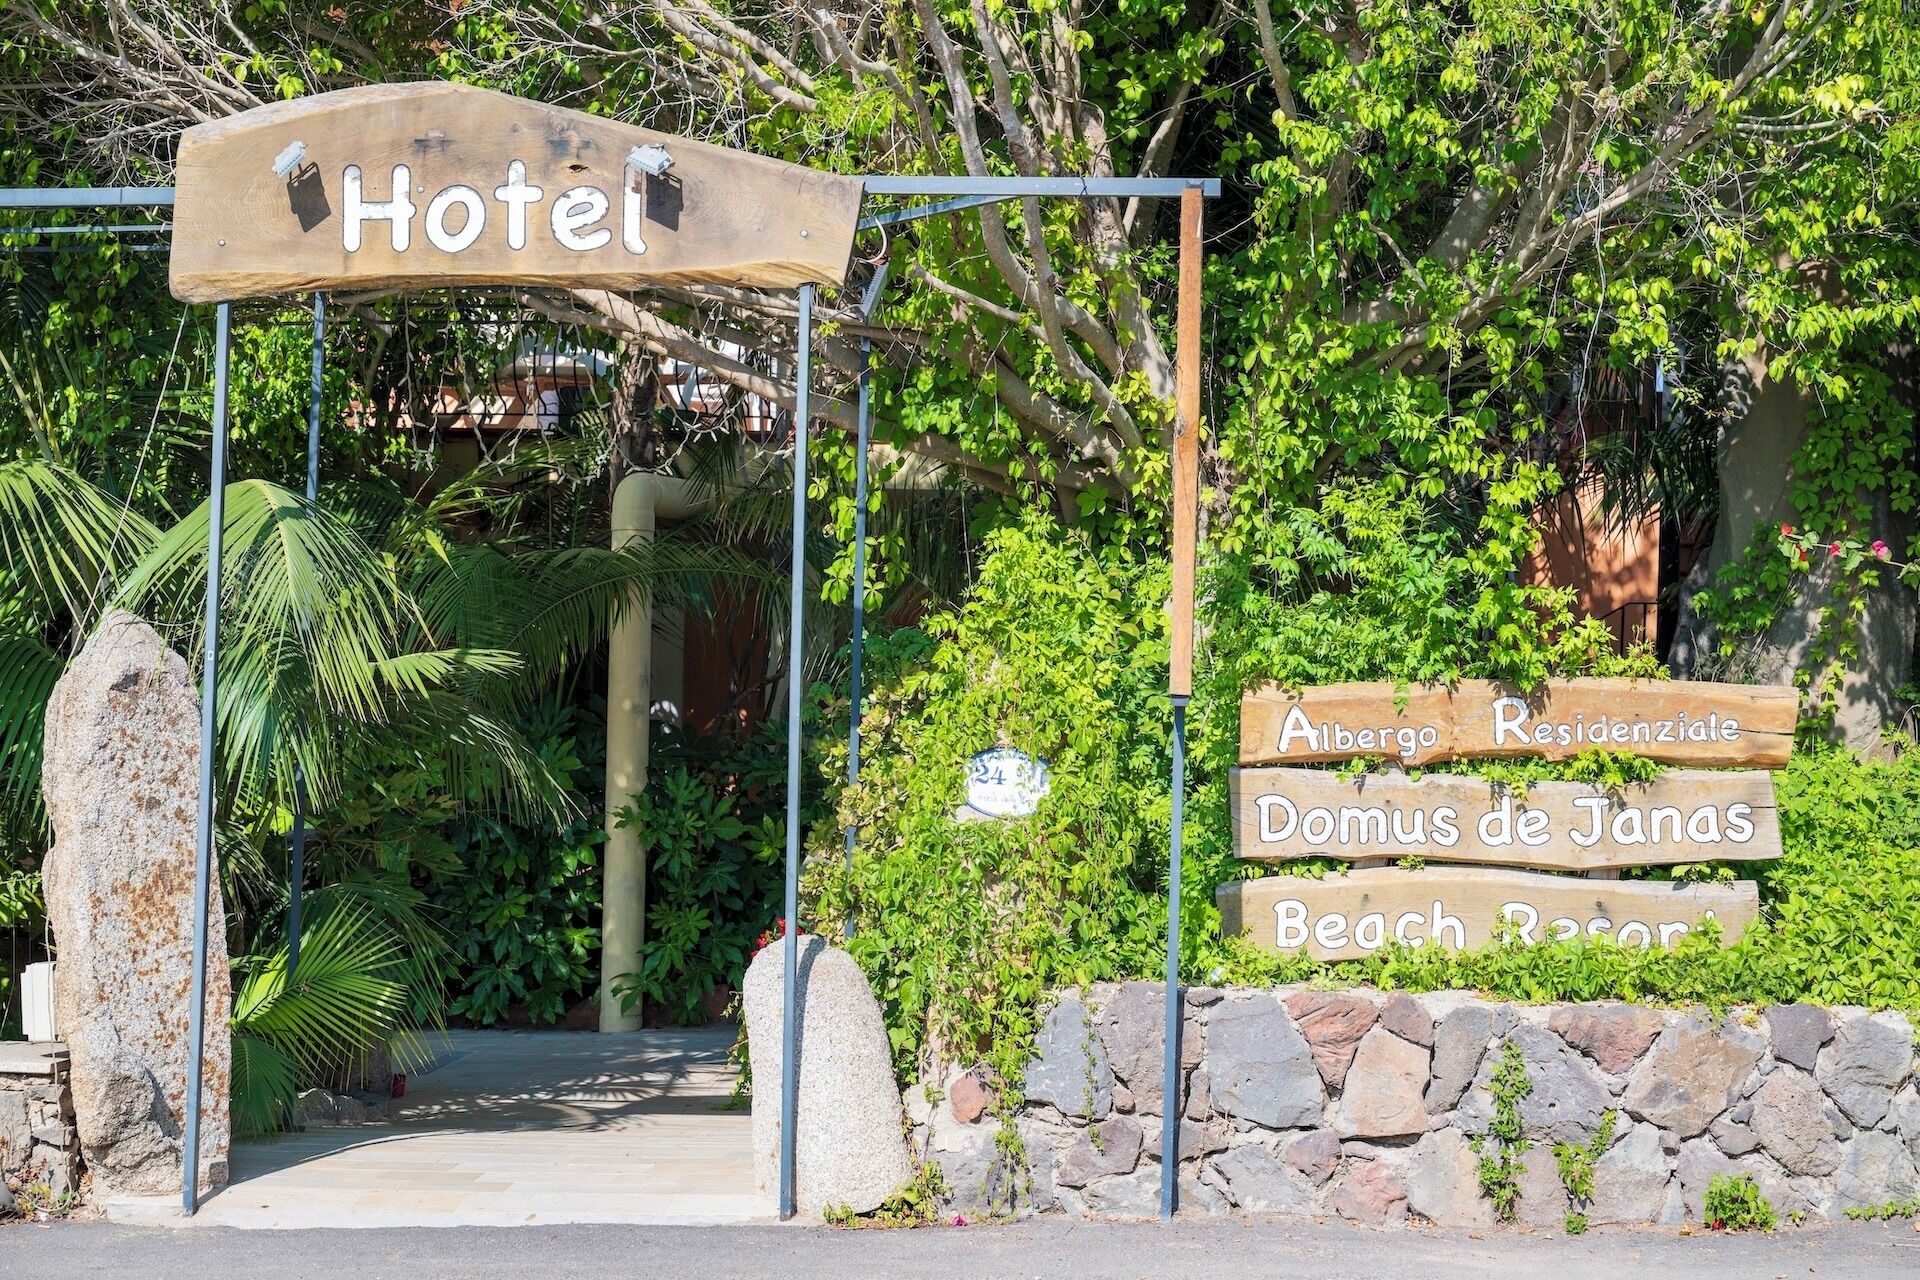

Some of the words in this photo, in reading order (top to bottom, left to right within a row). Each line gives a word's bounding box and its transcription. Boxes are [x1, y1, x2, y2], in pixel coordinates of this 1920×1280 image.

[342, 159, 647, 255] Hotel
[1278, 705, 1438, 758] Albergo
[1491, 696, 1740, 747] Residenziale
[975, 764, 1007, 785] 24
[1255, 795, 1461, 847] Domus
[1478, 796, 1551, 847] de
[1570, 796, 1756, 847] Janas
[1273, 900, 1466, 951] Beach
[1500, 901, 1716, 951] Resor
